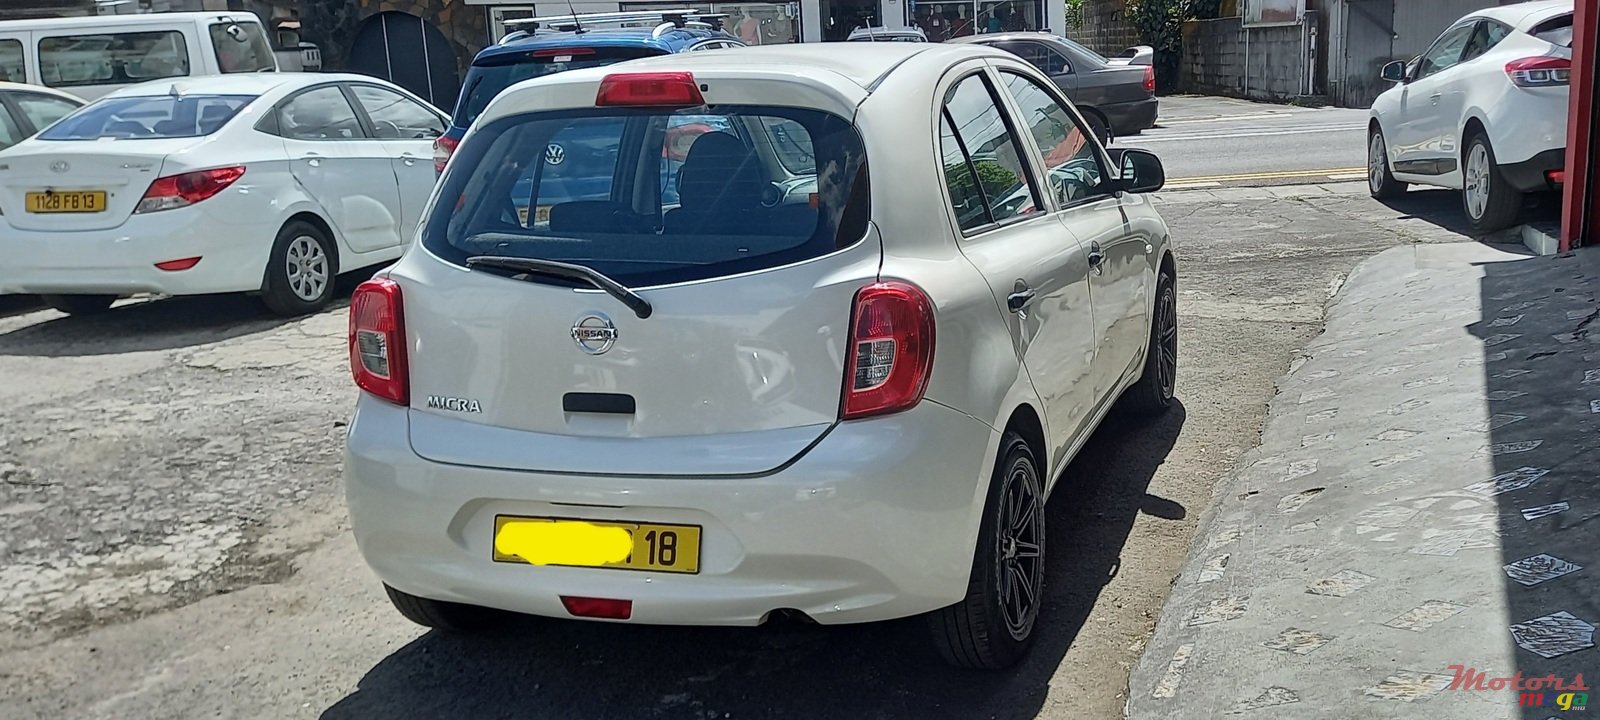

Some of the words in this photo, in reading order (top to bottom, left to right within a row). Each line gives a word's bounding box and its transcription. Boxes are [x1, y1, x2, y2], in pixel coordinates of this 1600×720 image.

[35, 195, 60, 209] 1128
[64, 194, 79, 209] FB
[82, 194, 94, 209] 13
[574, 329, 612, 339] NISSAN
[427, 395, 482, 414] MICRA
[645, 530, 678, 566] 18
